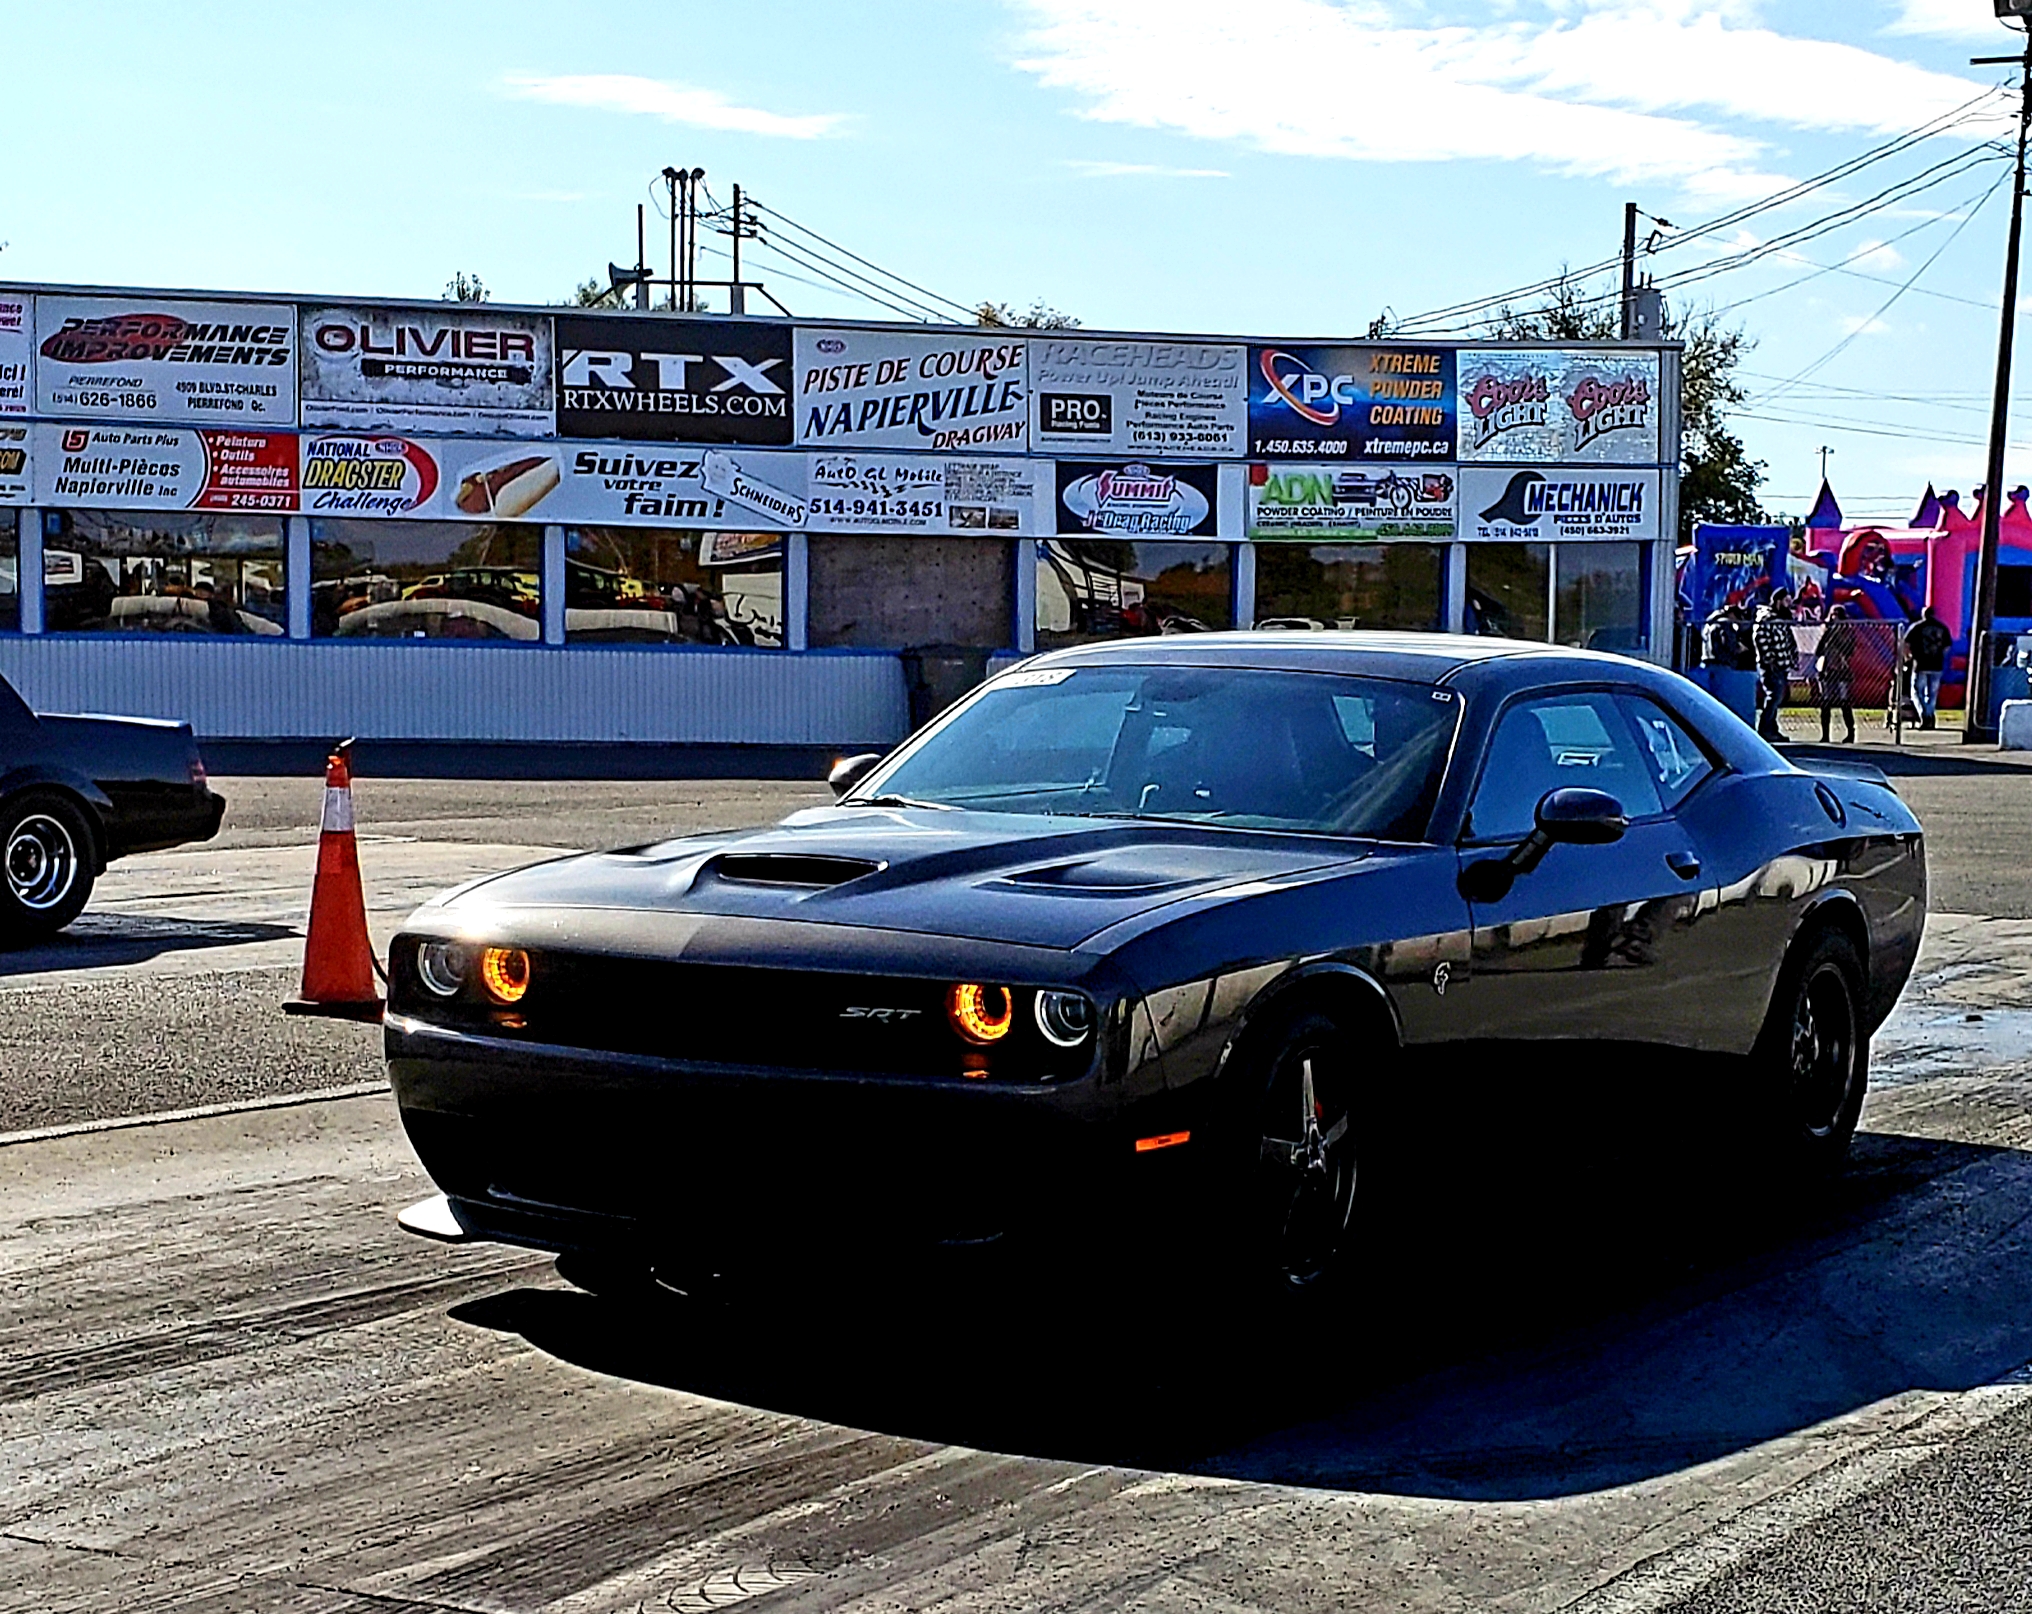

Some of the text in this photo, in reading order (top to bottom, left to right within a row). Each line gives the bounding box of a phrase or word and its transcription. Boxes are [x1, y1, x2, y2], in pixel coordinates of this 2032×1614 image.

[61, 317, 290, 345] PERFORMANCE
[51, 339, 291, 366] IMPROVEMENTS
[315, 324, 535, 362] OLIVIER
[1040, 343, 1238, 370] RACEHEADS
[1369, 353, 1442, 374] XTREME
[384, 363, 508, 379] PERFORMANCE
[562, 350, 786, 394] RTX
[803, 344, 1025, 395] PISTE DE COURSE
[1038, 369, 1239, 389] Power Up! Jump Ahead!
[1262, 374, 1354, 406] XPC
[1369, 379, 1443, 400] POWDER
[563, 389, 787, 417] RTXWHEELS.COM
[803, 380, 1024, 439] NAPIERVILLE
[1369, 405, 1443, 426] COATING
[91, 432, 179, 447] Auto Parts Plus
[216, 435, 267, 448] Peinture
[932, 421, 1026, 449] DRAGWAY
[220, 449, 255, 462] Outils
[306, 441, 371, 457] NATIONAL
[1254, 437, 1450, 458] 1.450.635.4000 xtremepc.ca
[62, 456, 181, 478] Multi-Pièces
[219, 464, 290, 477] Accessoires
[304, 459, 405, 489] DRAGSTER
[573, 452, 701, 480] Suivez
[895, 468, 943, 483] Mobile
[54, 476, 178, 498] Napierville Inc
[219, 475, 290, 488] automobiles
[604, 479, 662, 491] votre
[1258, 473, 1333, 506] ADN
[312, 491, 414, 516] Challenge
[809, 498, 943, 518] 514-941-3451
[1527, 482, 1645, 513] MECHANICK
[1102, 511, 1140, 533] Drag
[1141, 512, 1192, 534] Racing
[1257, 507, 1299, 517] POWDER
[1301, 507, 1345, 517] COATING
[1415, 507, 1452, 517] POUDRE
[1594, 512, 1642, 524] D'AUTOS
[839, 1006, 922, 1023] SRT
